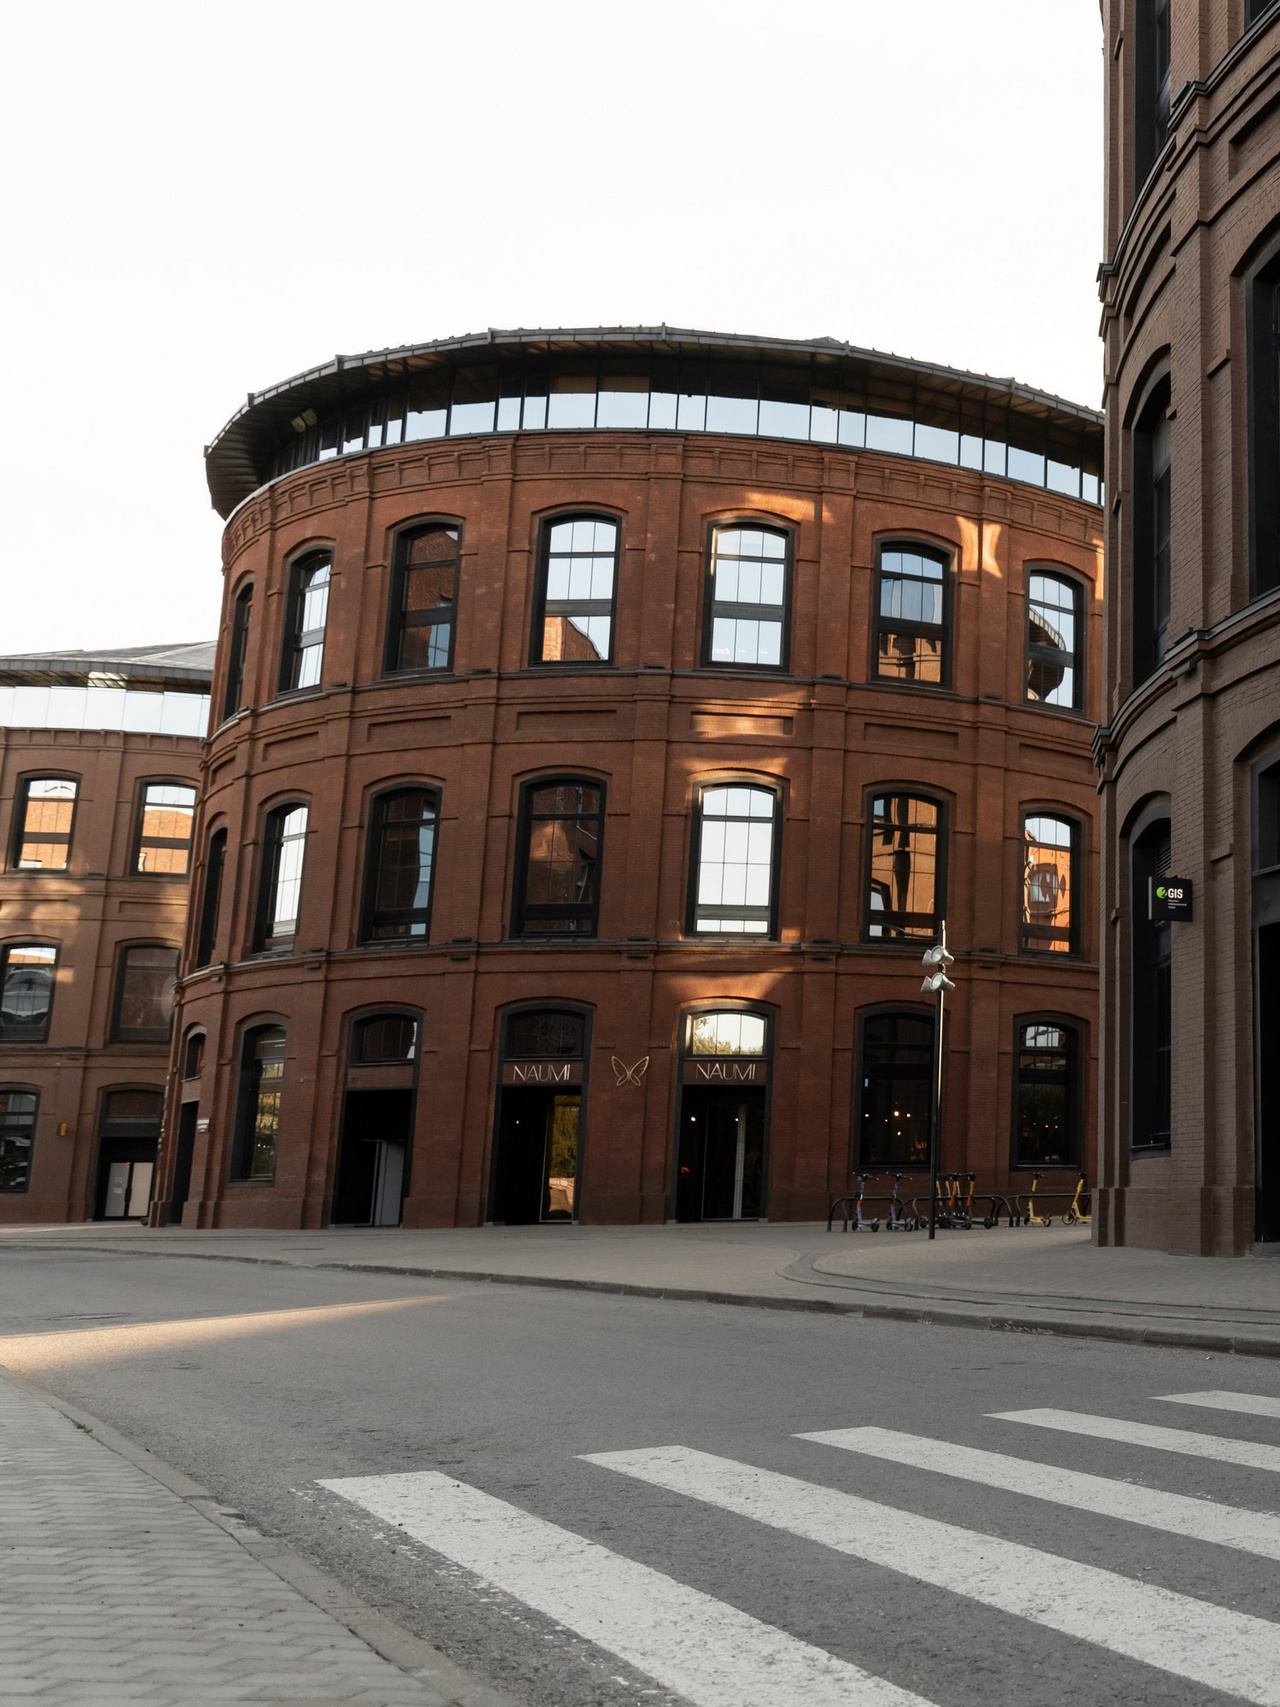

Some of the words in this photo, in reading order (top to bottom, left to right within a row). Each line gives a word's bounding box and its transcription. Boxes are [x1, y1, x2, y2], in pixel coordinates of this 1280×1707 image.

[1157, 887, 1184, 899] 2GIS
[513, 1064, 571, 1082] NAUMI
[695, 1062, 756, 1080] NAUMI
